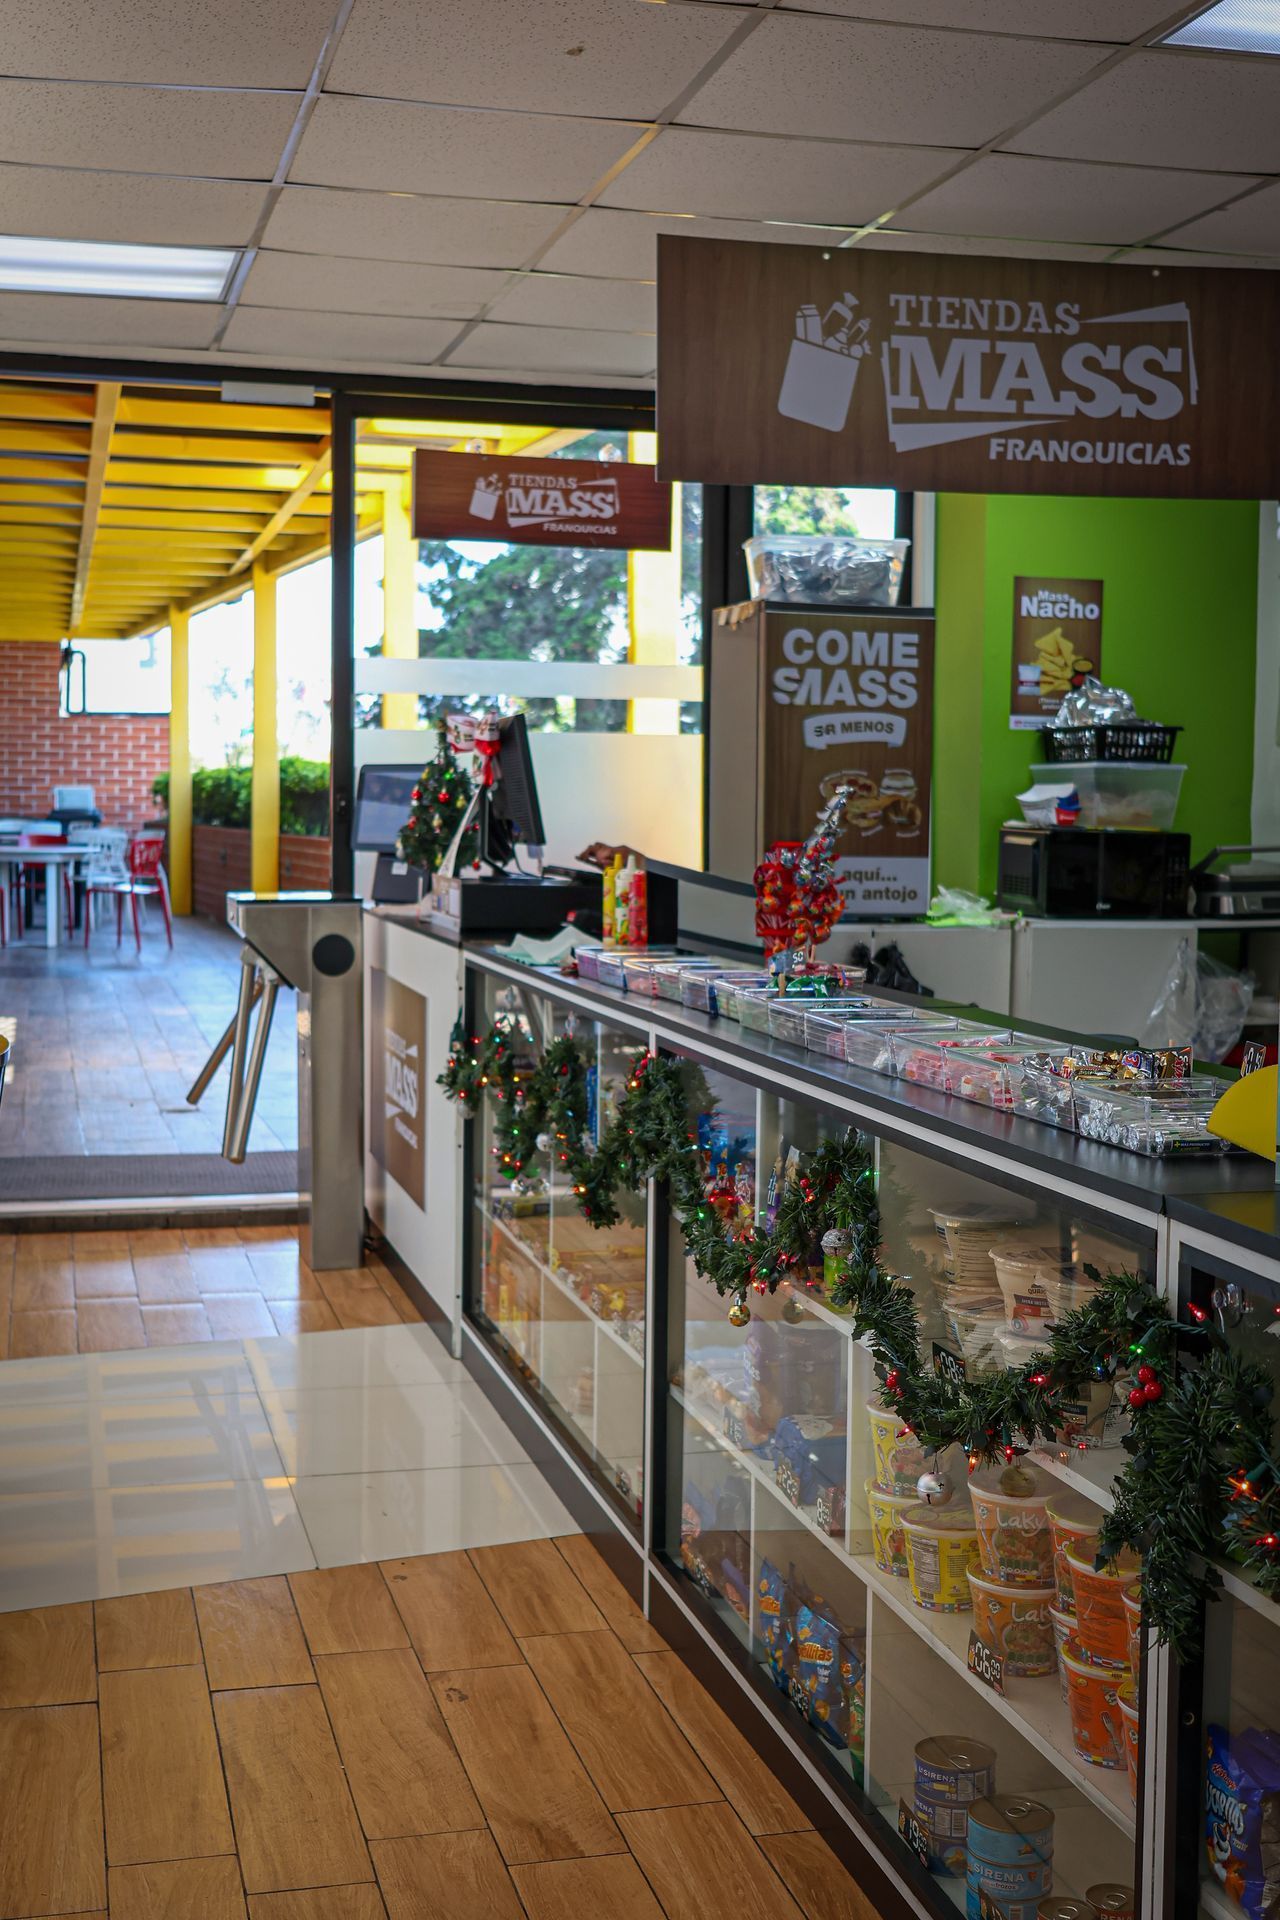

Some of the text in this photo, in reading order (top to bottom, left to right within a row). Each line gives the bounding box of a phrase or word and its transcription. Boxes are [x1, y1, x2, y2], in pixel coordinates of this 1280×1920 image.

[889, 293, 1081, 336] TIENDAS
[889, 334, 1184, 421] MASS
[988, 437, 1191, 467] FRANQUICIAS
[508, 473, 578, 489] TIENDAS
[507, 487, 615, 520] MASS
[542, 522, 618, 535] FRANQUICIAS
[1020, 594, 1100, 620] Nacho
[1037, 589, 1070, 602] Mass
[782, 628, 920, 668] COME
[840, 721, 894, 734] MENOS
[861, 886, 918, 902] antojo
[996, 1507, 1047, 1537] Laky
[974, 1863, 1025, 1883] SIRENA
